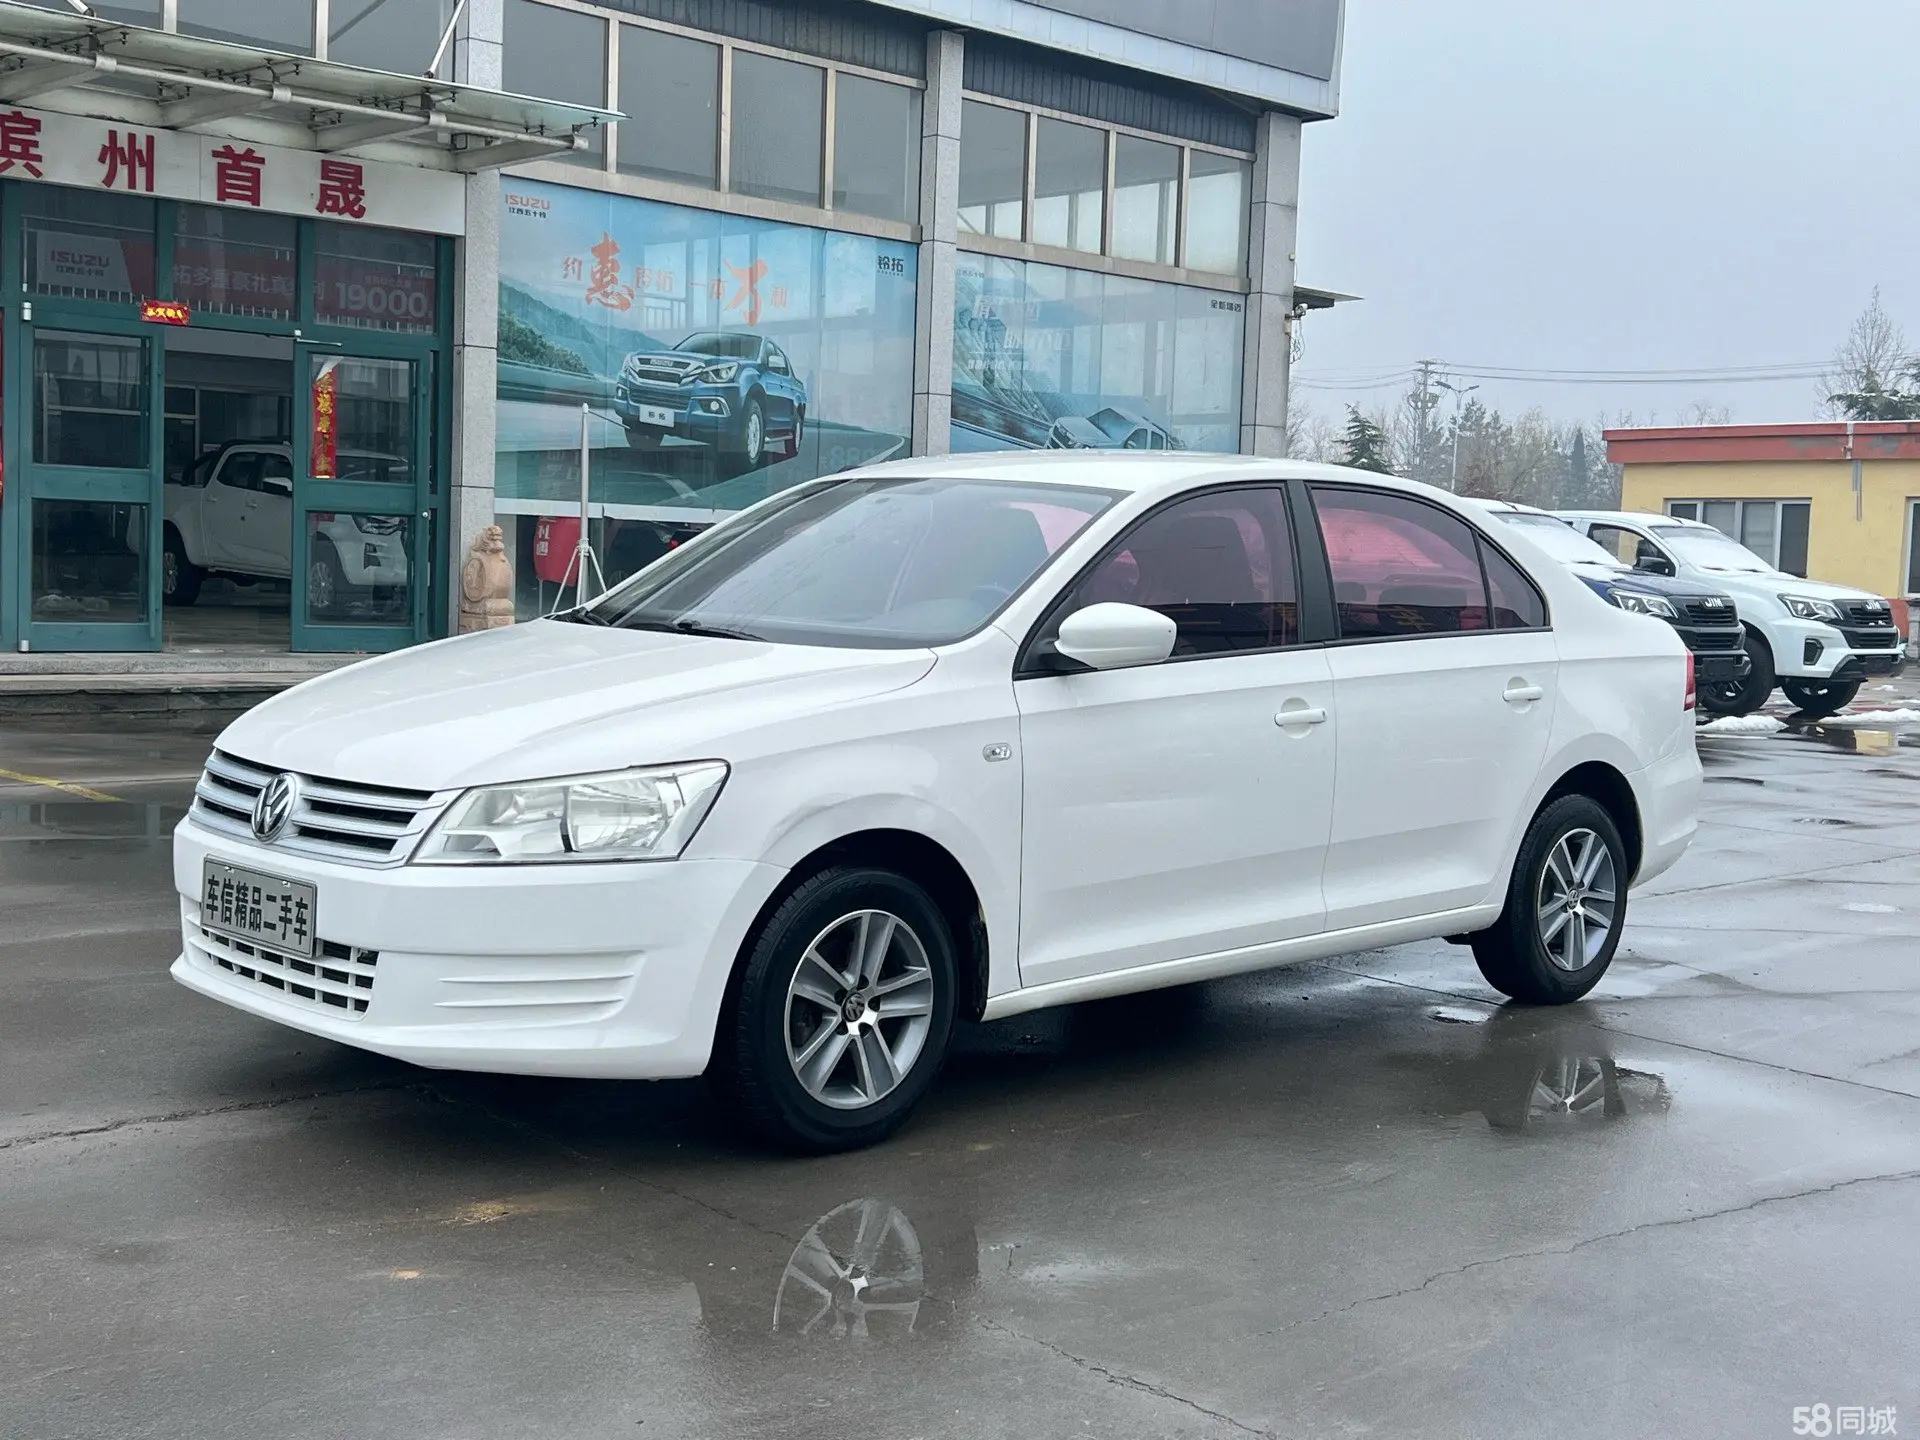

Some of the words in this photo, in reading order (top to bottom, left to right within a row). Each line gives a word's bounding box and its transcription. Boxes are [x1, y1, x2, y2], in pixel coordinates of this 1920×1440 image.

[504, 193, 551, 210] ISUZU
[50, 249, 110, 268] ISUZU
[877, 255, 904, 273] 铃拓
[334, 280, 428, 318] 19000
[1704, 596, 1724, 608] JIM
[1865, 600, 1882, 610] JIM
[206, 875, 308, 945] 车信精品二手车
